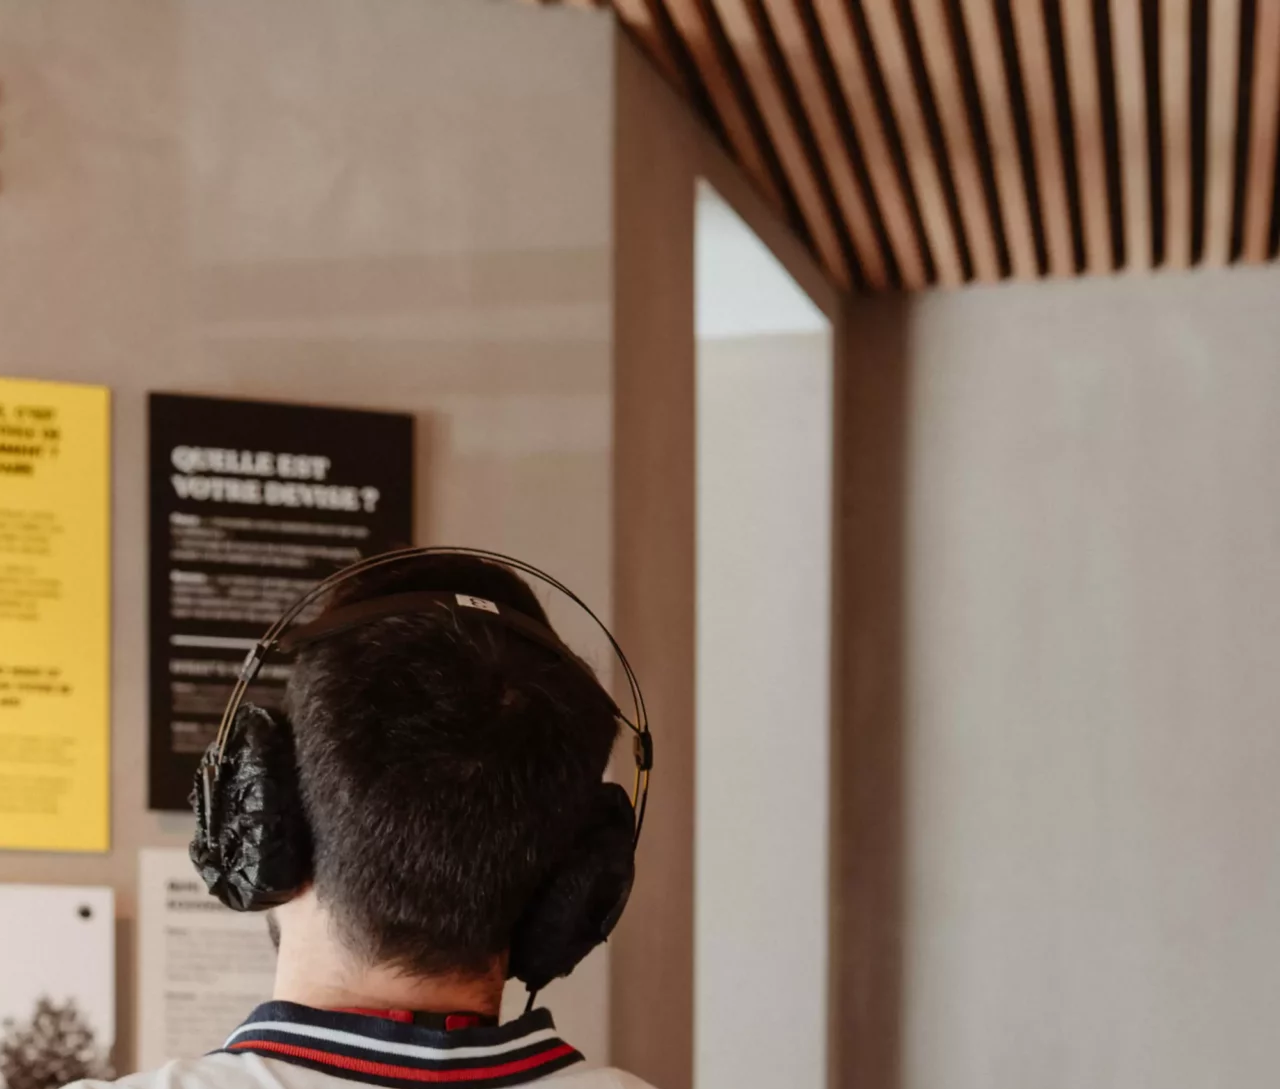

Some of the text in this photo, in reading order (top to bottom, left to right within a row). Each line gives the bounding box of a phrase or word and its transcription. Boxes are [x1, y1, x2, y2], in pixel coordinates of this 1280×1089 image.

[171, 445, 331, 480] QUELLE EST
[170, 473, 262, 504] VOTRE
